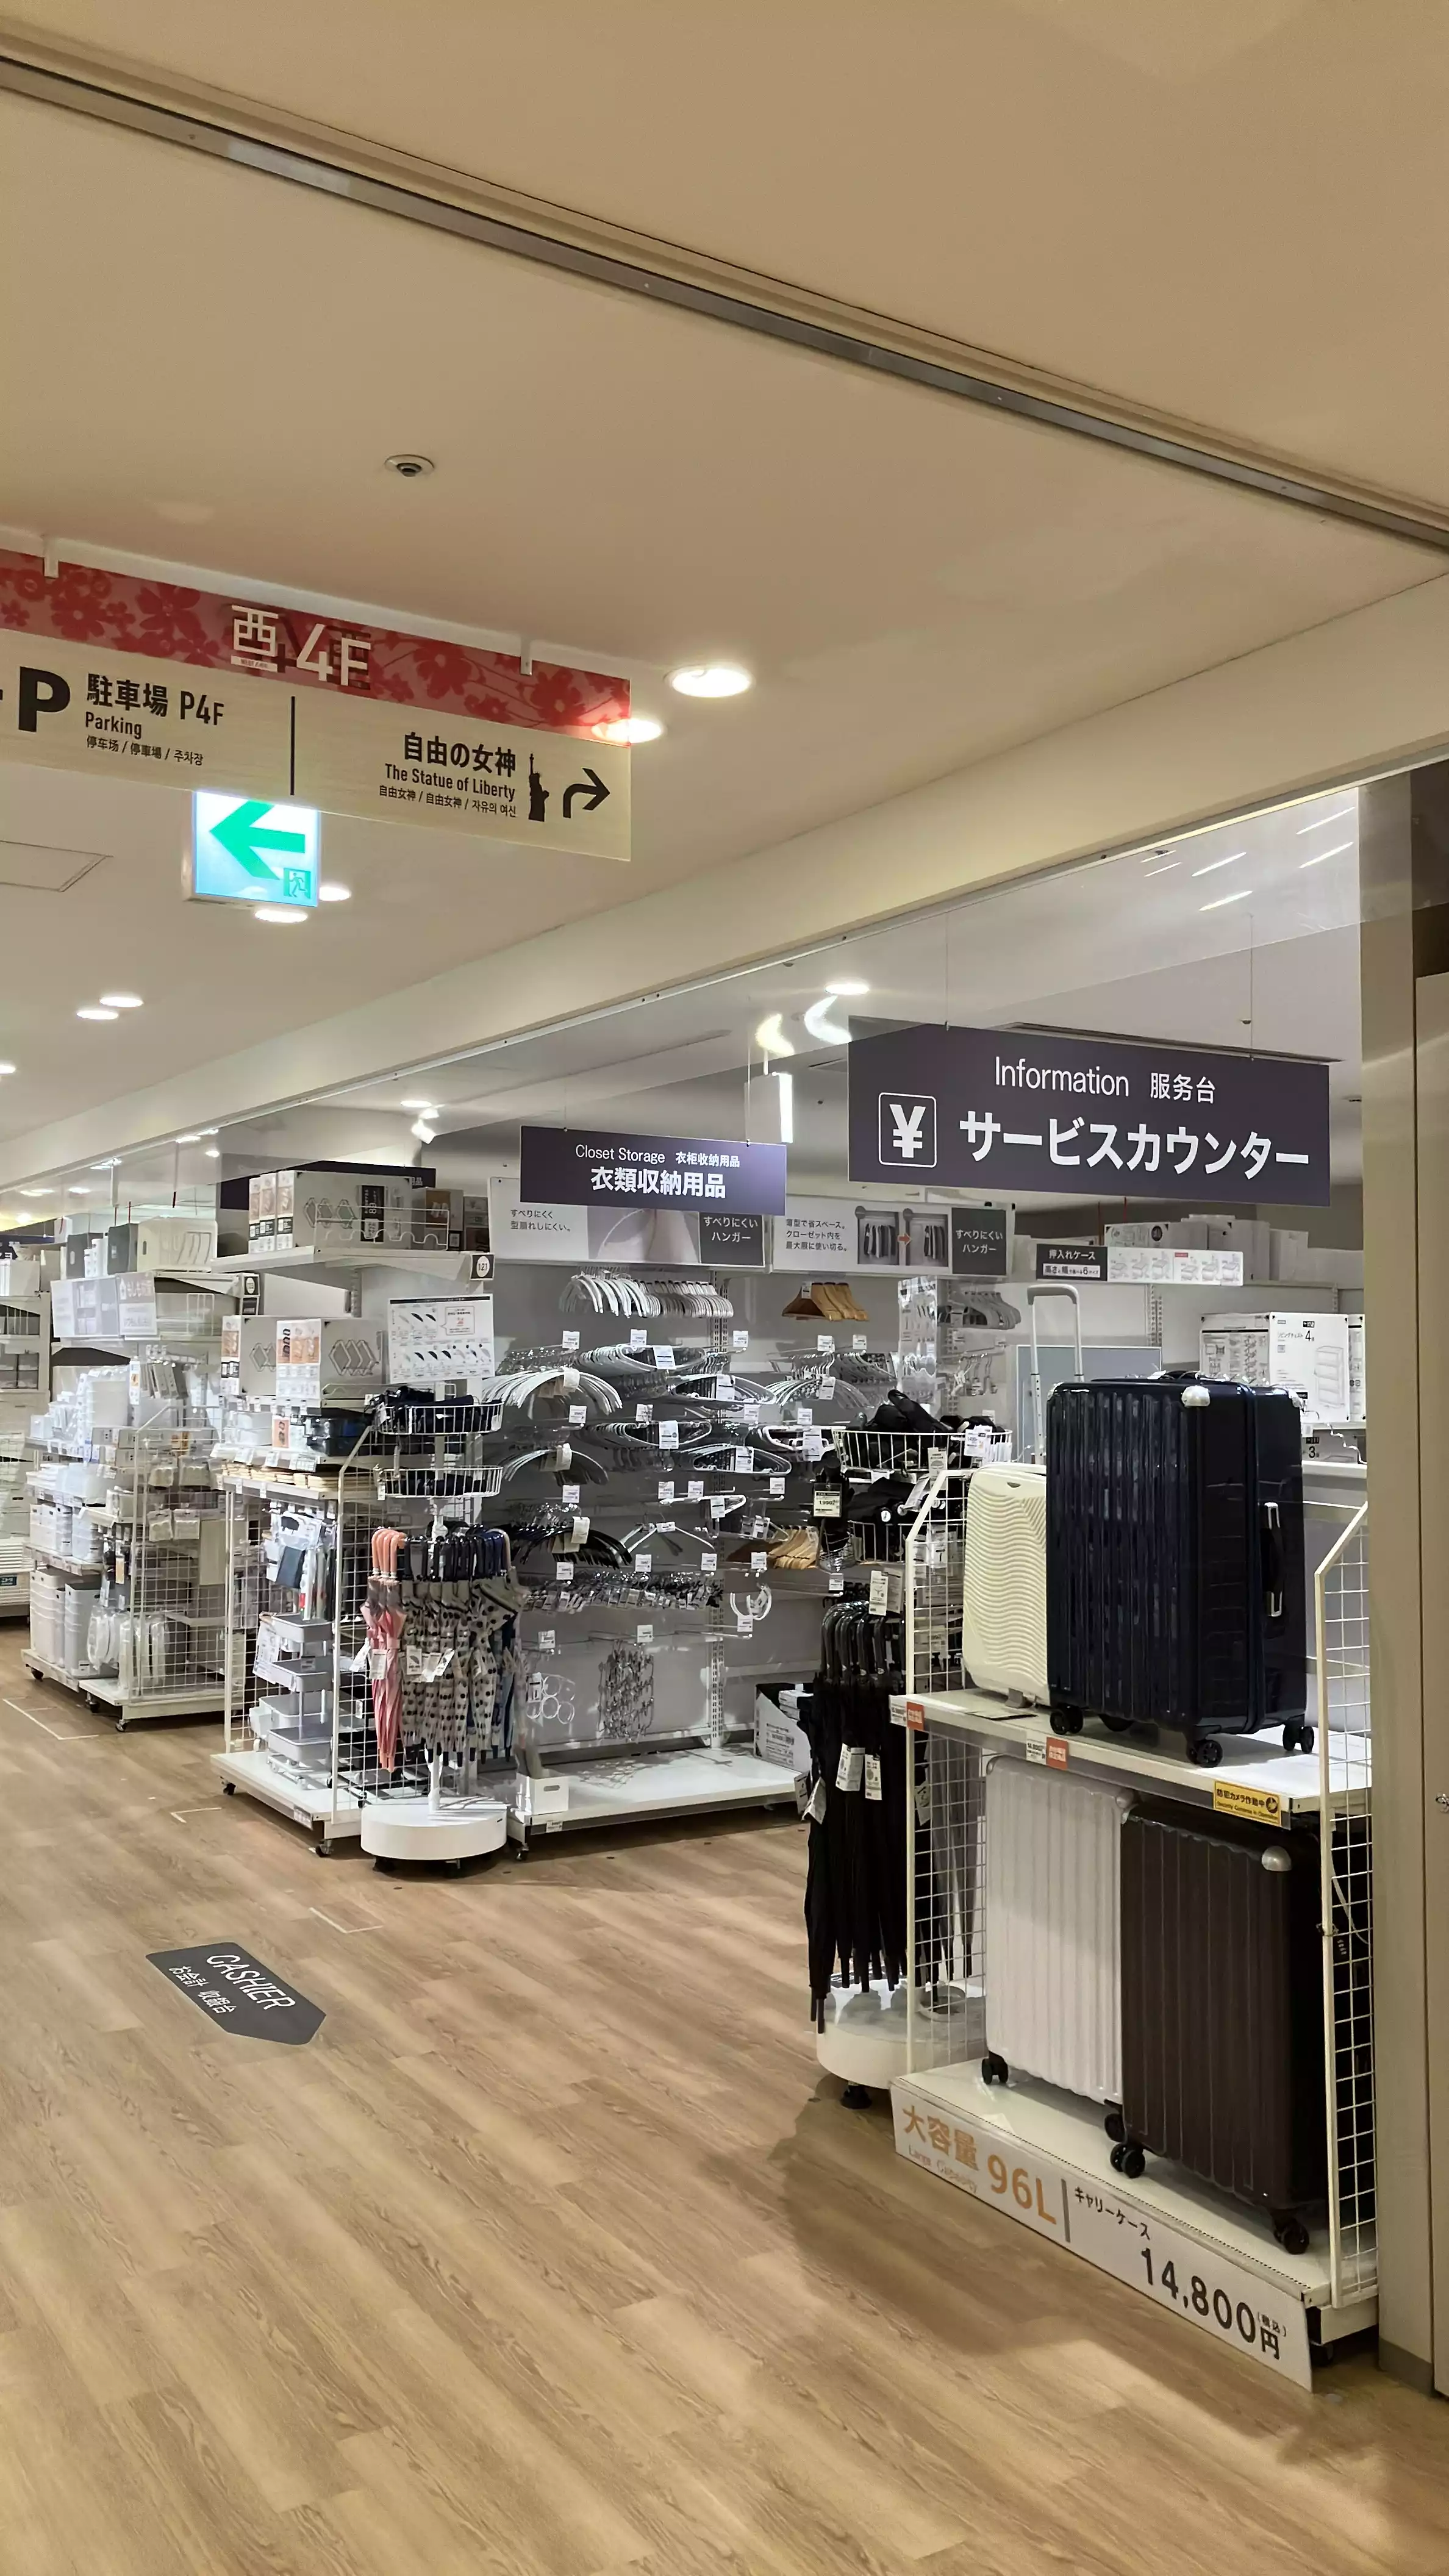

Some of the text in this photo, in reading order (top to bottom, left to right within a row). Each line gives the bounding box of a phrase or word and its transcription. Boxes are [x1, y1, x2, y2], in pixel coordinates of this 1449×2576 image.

[232, 604, 371, 686] 西 4F
[18, 666, 70, 732] P
[86, 673, 224, 726] 駐車場 P4F
[85, 711, 142, 740] Parking
[87, 735, 120, 753] 停车场
[131, 742, 162, 760] 停車場
[174, 750, 204, 766] 주차장
[404, 732, 516, 778] 自由の女神
[385, 763, 515, 803] The Statue of Liberty
[379, 785, 416, 801] 自由女神
[426, 793, 462, 809] 自由女神
[472, 800, 497, 815] 자유의
[500, 804, 517, 818] 여신
[995, 1056, 1217, 1104] Information 服务台
[575, 1143, 740, 1168] Closet Storage 衣柜收纳用品
[959, 1110, 1309, 1180] サービスカウンター
[590, 1167, 726, 1199] 衣類収納用品
[510, 1209, 553, 1219] すべりにくく
[703, 1216, 759, 1228] すべりにくい
[711, 1231, 751, 1242] ハンガー
[786, 1231, 840, 1240] クローゼット内を
[956, 1229, 1003, 1240] すべりにくい
[962, 1244, 996, 1254] ハンガー
[1049, 1249, 1096, 1260] 押入れケース
[168, 1966, 209, 1987] お会計
[206, 1955, 296, 2010] CASHIER
[903, 2105, 1057, 2225] 大容量 96L
[1075, 2186, 1150, 2241] キャリーケース
